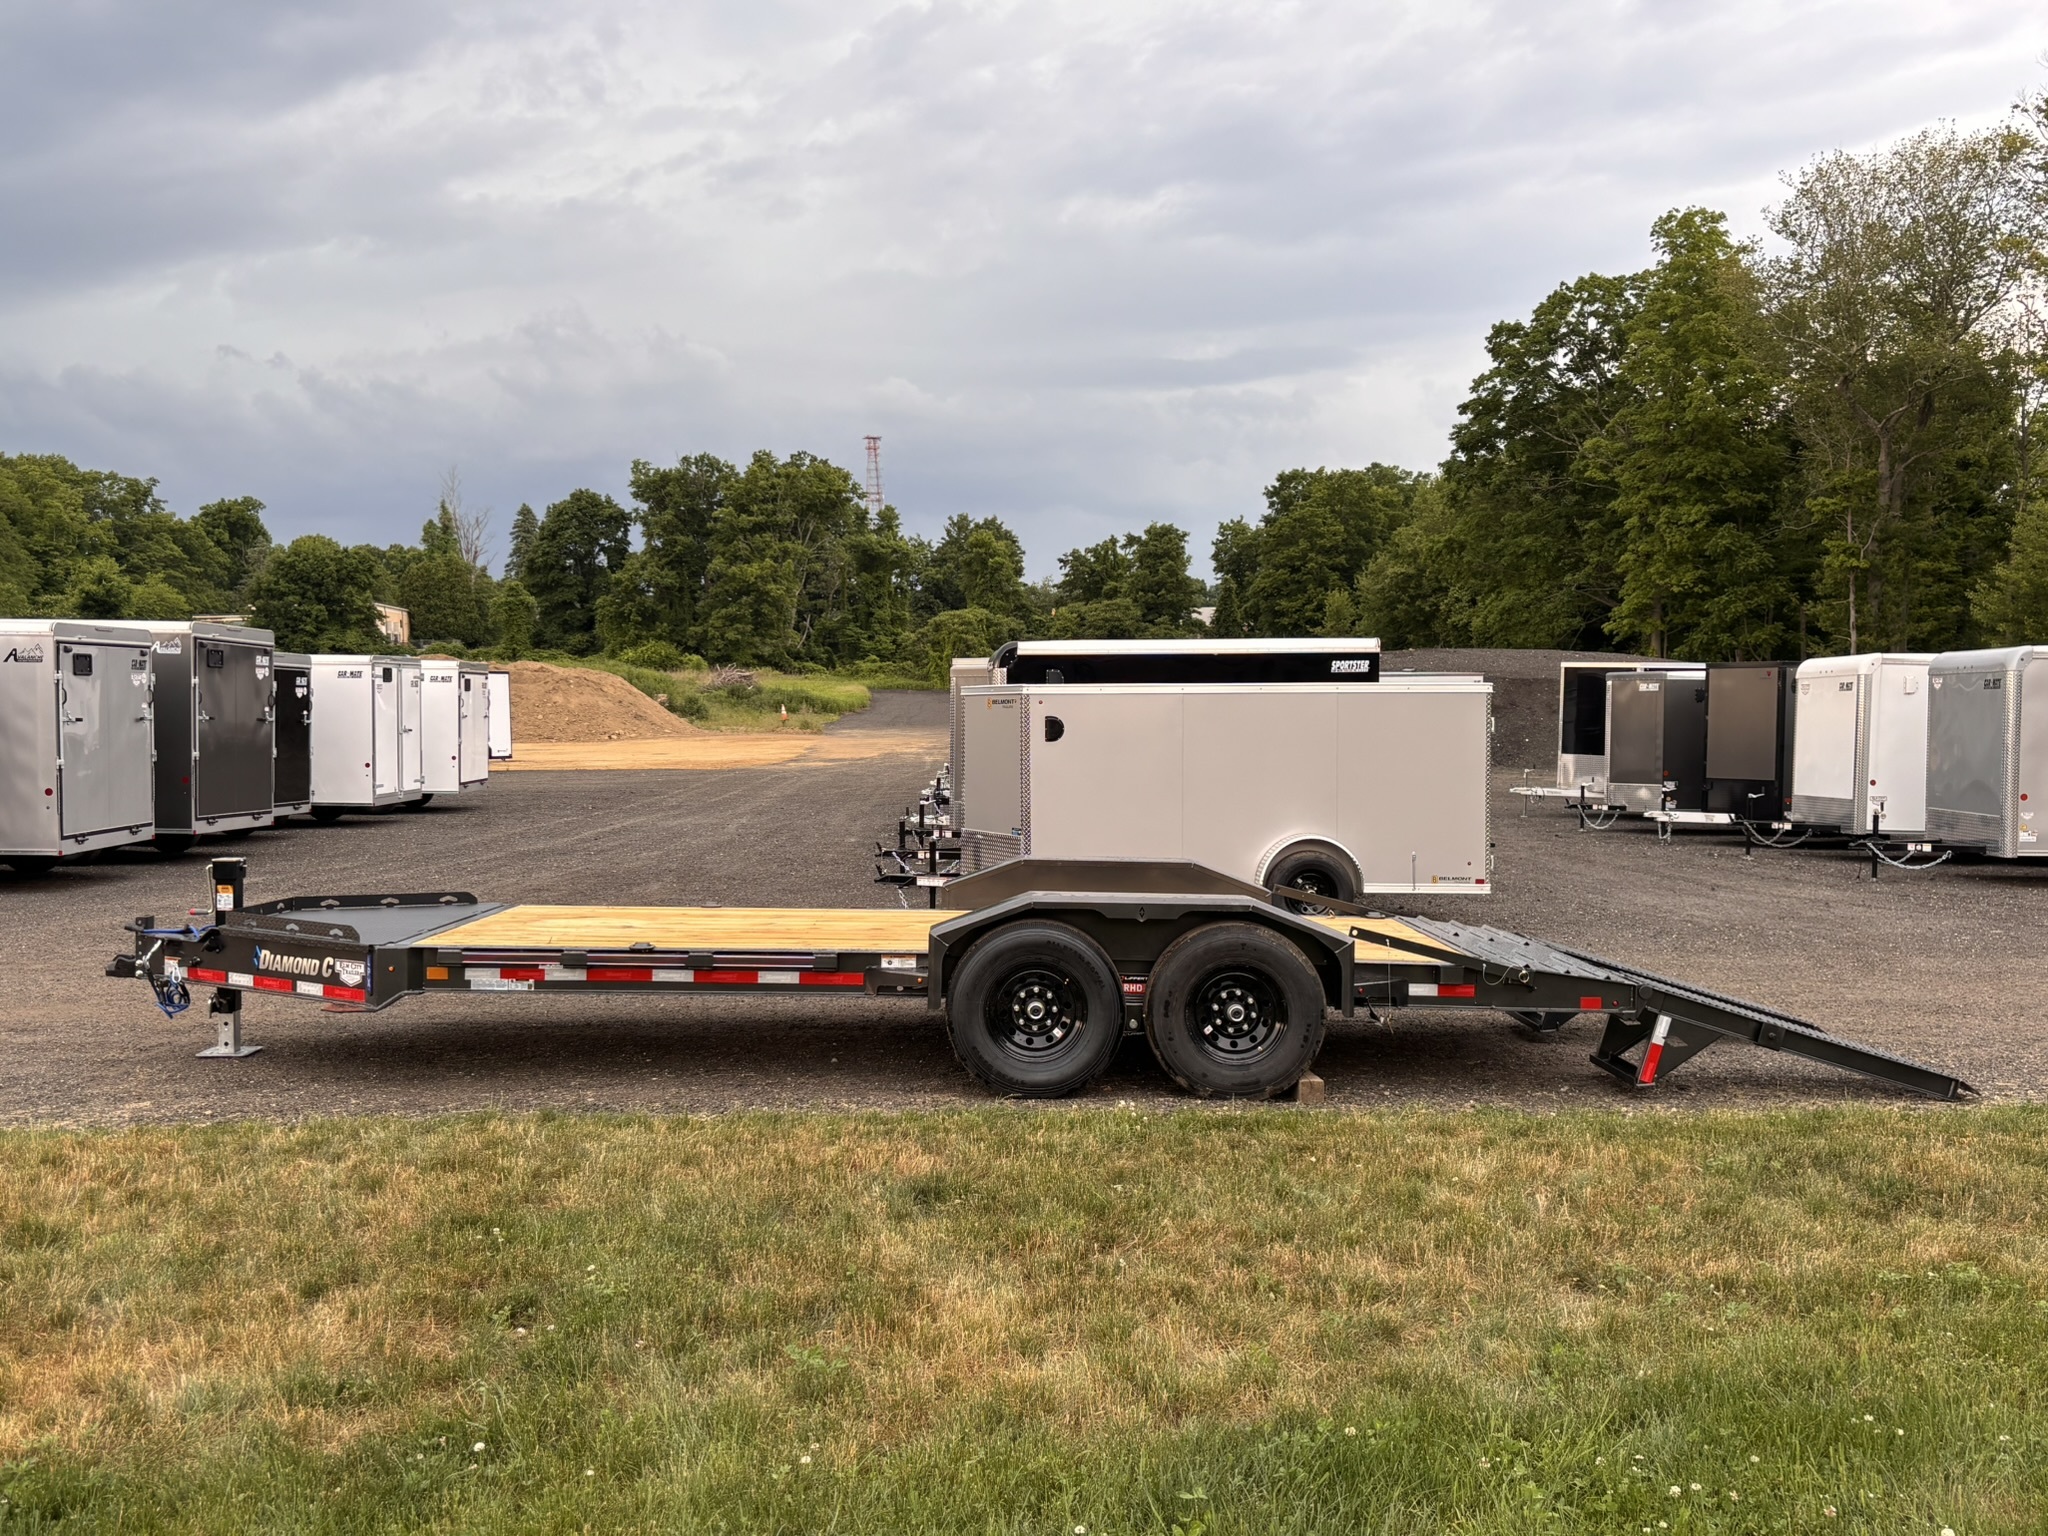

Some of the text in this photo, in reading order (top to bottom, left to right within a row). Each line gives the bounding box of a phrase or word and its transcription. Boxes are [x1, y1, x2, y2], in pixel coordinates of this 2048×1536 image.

[1331, 660, 1370, 669] SPORTSTER
[259, 949, 334, 978] DIAMOND C
[1123, 983, 1143, 992] RHD
